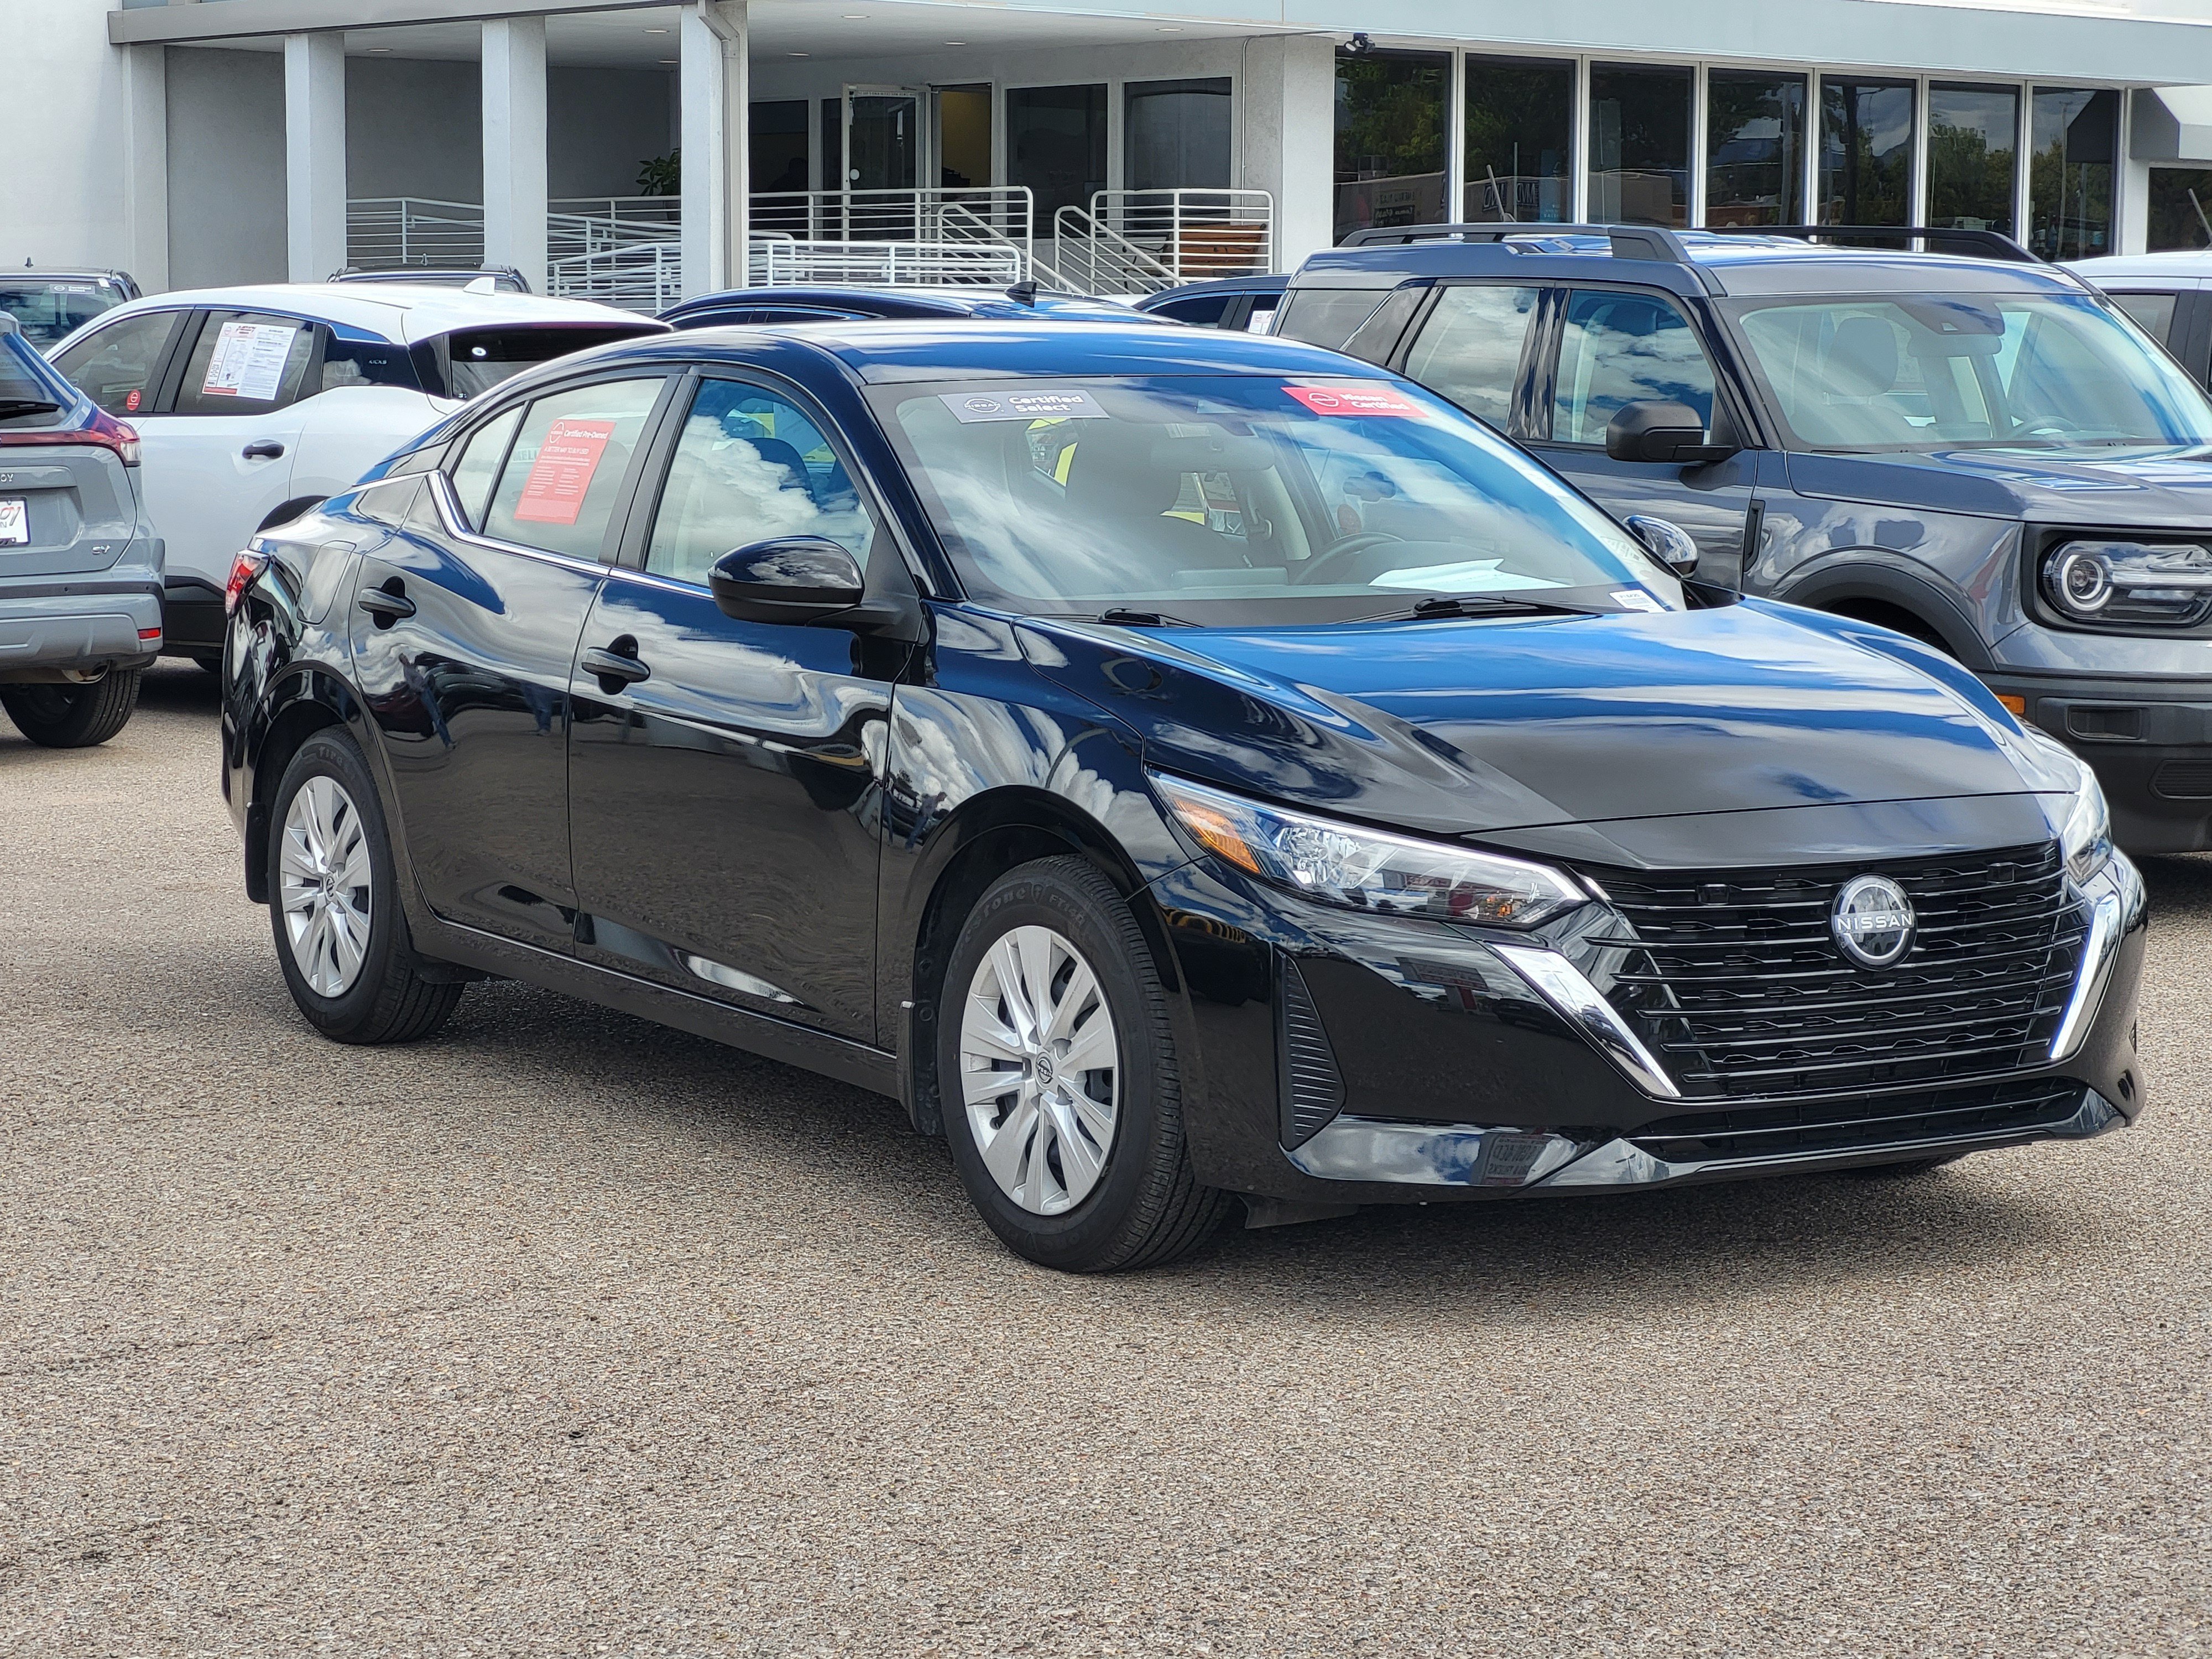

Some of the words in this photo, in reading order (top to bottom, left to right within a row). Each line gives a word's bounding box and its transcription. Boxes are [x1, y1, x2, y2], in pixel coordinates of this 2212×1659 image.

[1008, 395, 1084, 405] Certified
[1339, 393, 1389, 402] Nissan
[1014, 404, 1072, 413] Select
[1350, 401, 1411, 411] Certified
[92, 545, 111, 555] SV
[1837, 912, 1913, 931] NISSAN
